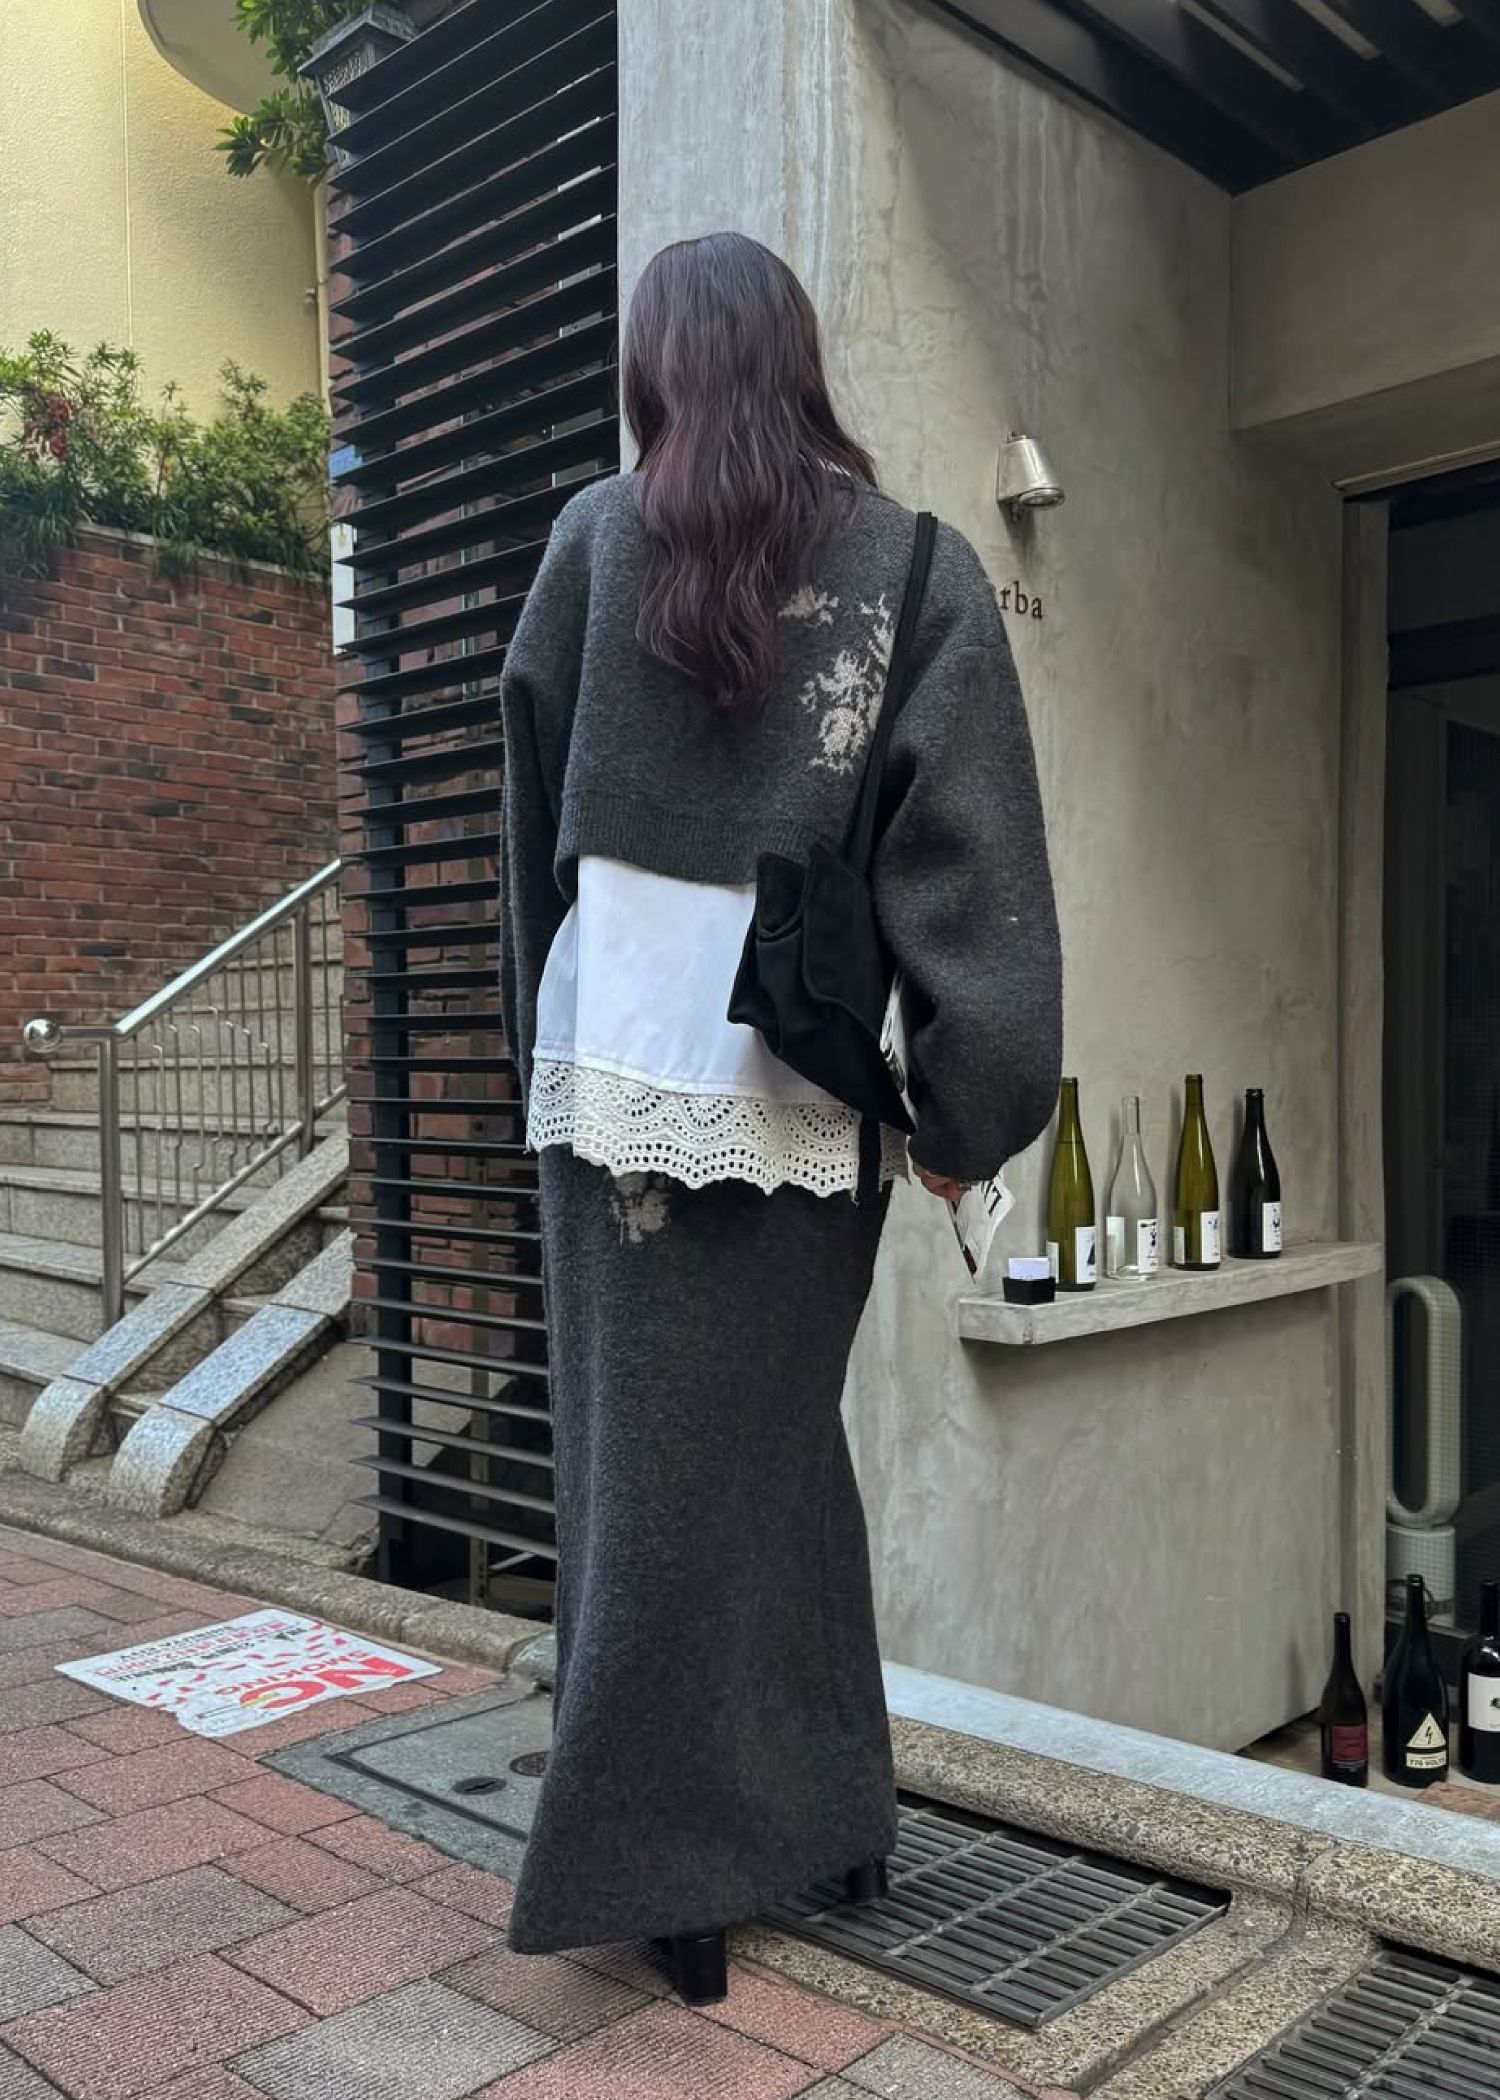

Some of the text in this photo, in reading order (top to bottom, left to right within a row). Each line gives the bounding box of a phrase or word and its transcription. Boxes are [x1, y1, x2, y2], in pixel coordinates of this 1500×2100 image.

[998, 580, 1043, 620] rba
[214, 1650, 368, 1696] SMOKING
[239, 1656, 414, 1709] NO
